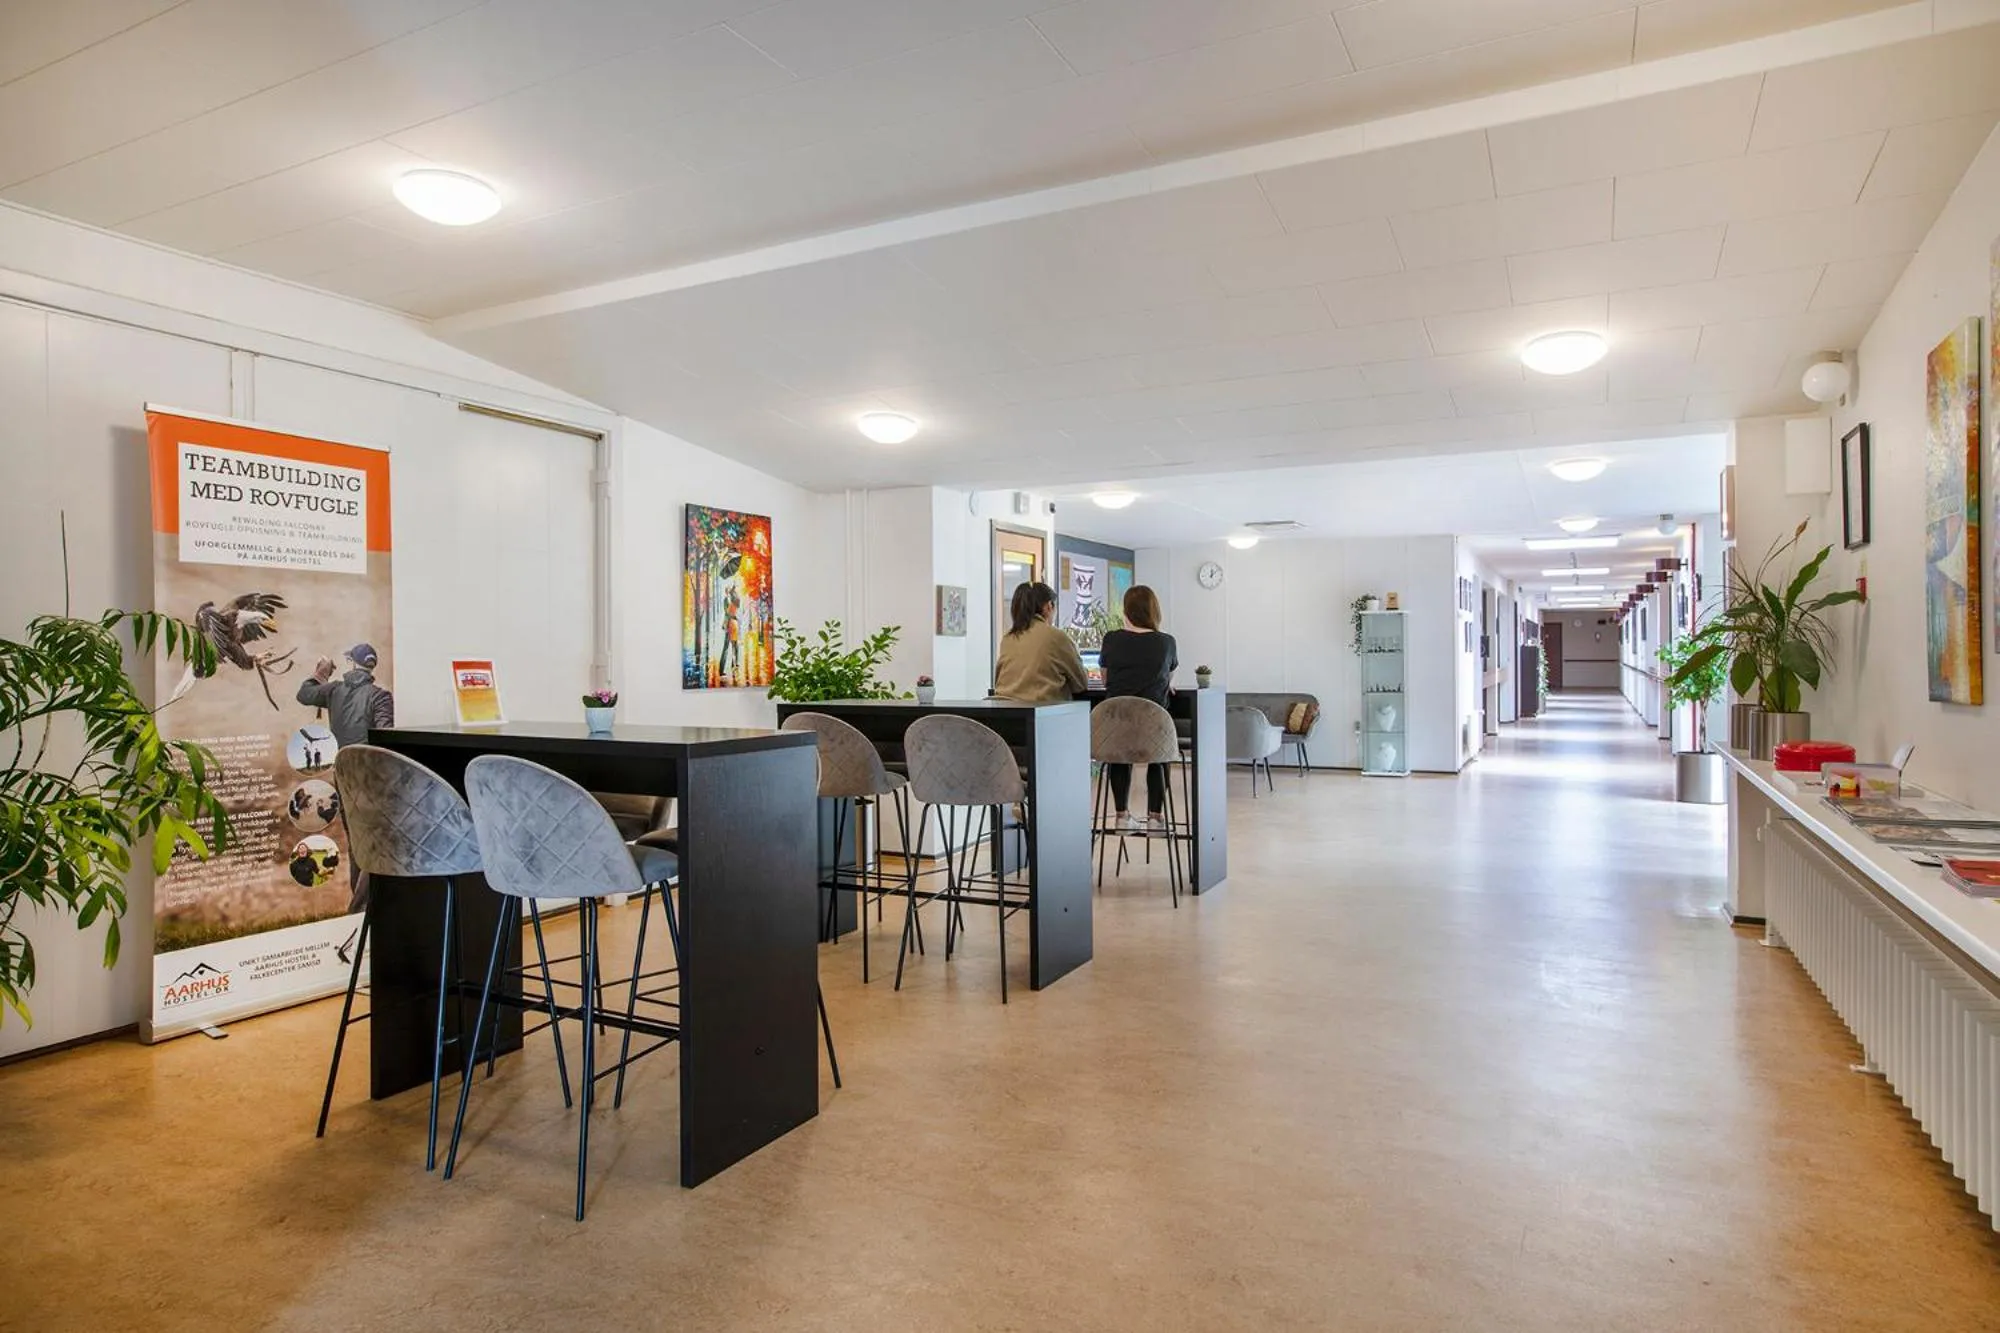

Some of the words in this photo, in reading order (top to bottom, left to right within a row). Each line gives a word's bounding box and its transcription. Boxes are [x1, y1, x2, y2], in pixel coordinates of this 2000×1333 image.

[185, 453, 362, 493] TEAMBUILDING
[190, 480, 244, 503] MED
[250, 488, 359, 517] ROVFUGLE
[194, 540, 274, 553] UFORGLEMMELIG
[251, 554, 287, 563] AARHUS
[290, 556, 322, 566] HOSTEL
[254, 959, 284, 972] AARHUS
[164, 974, 230, 1001] AARHUS
